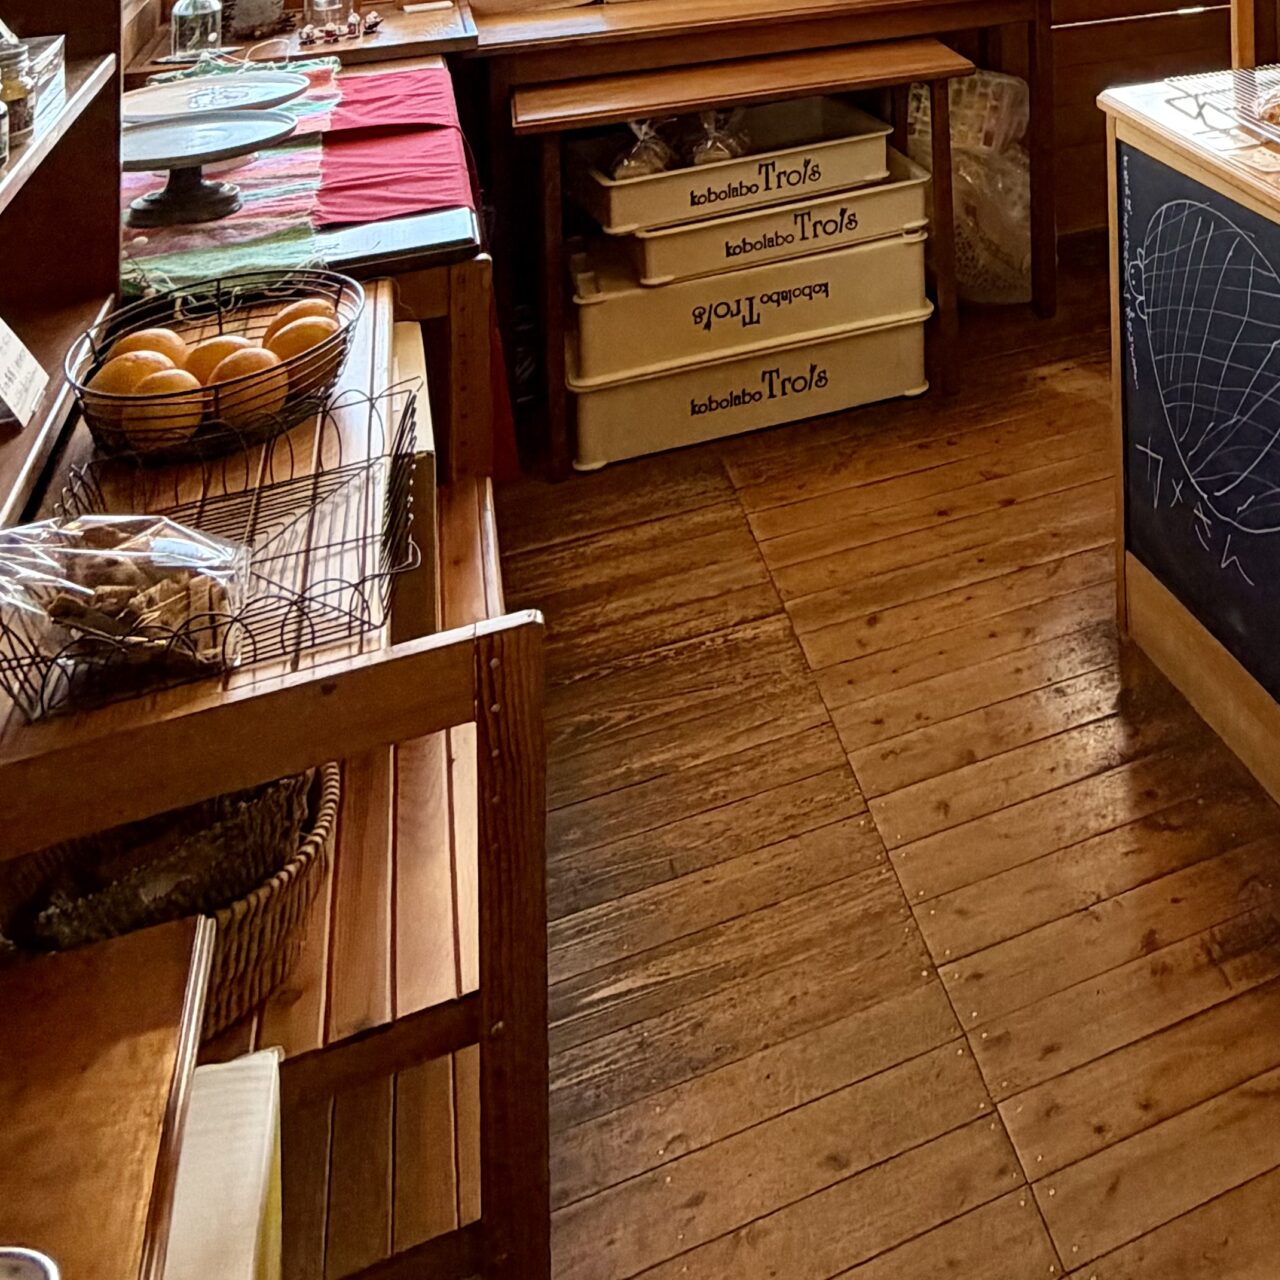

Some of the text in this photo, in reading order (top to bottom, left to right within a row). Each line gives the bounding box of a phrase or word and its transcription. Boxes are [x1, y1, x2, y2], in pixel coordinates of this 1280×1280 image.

[690, 182, 760, 207] kobolabo
[724, 230, 795, 258] kobolabo
[760, 282, 829, 308] kobolabo
[690, 391, 762, 417] kobolabo
